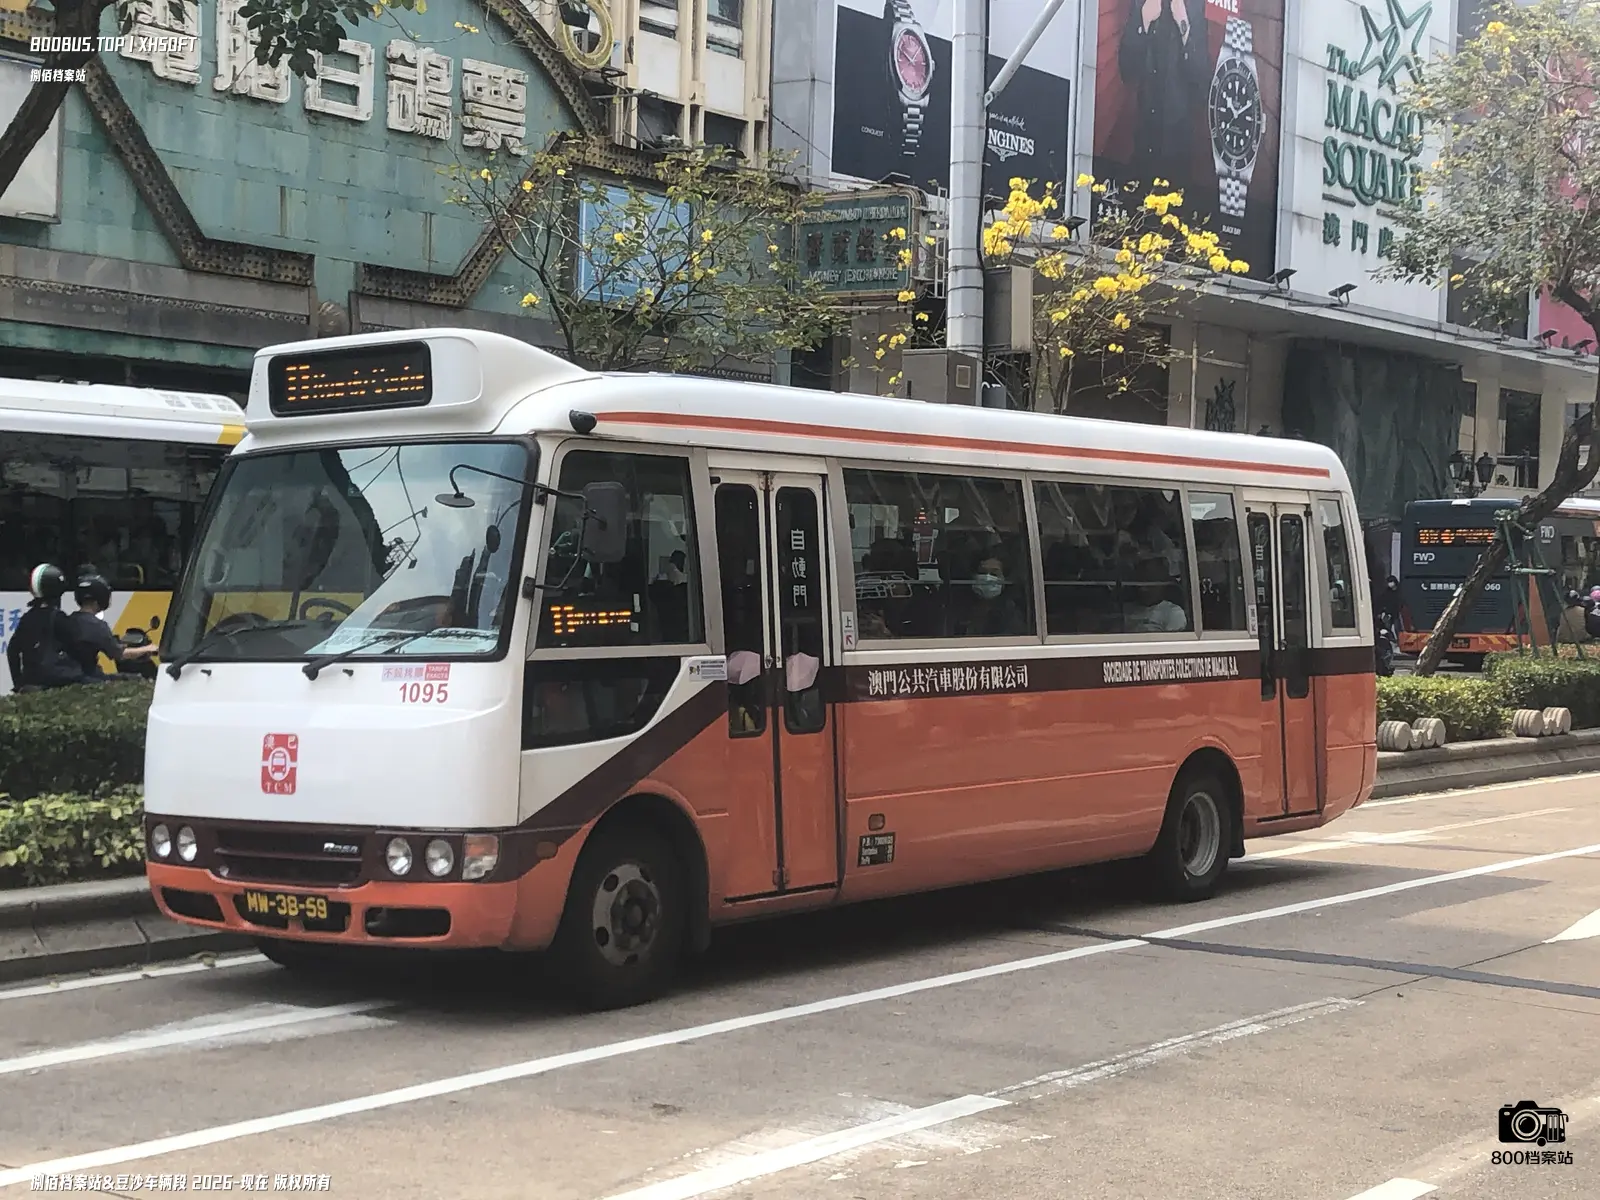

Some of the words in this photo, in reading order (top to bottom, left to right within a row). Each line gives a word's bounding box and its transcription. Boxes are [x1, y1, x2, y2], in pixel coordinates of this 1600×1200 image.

[1326, 43, 1360, 81] The
[1324, 79, 1424, 157] MACAU
[987, 128, 1035, 156] NGINES
[1323, 136, 1423, 212] SQUARE
[399, 682, 449, 703] 1095
[867, 664, 1029, 696] 澳門公共汽車股份有限公司
[246, 891, 328, 919] MW-38-59
